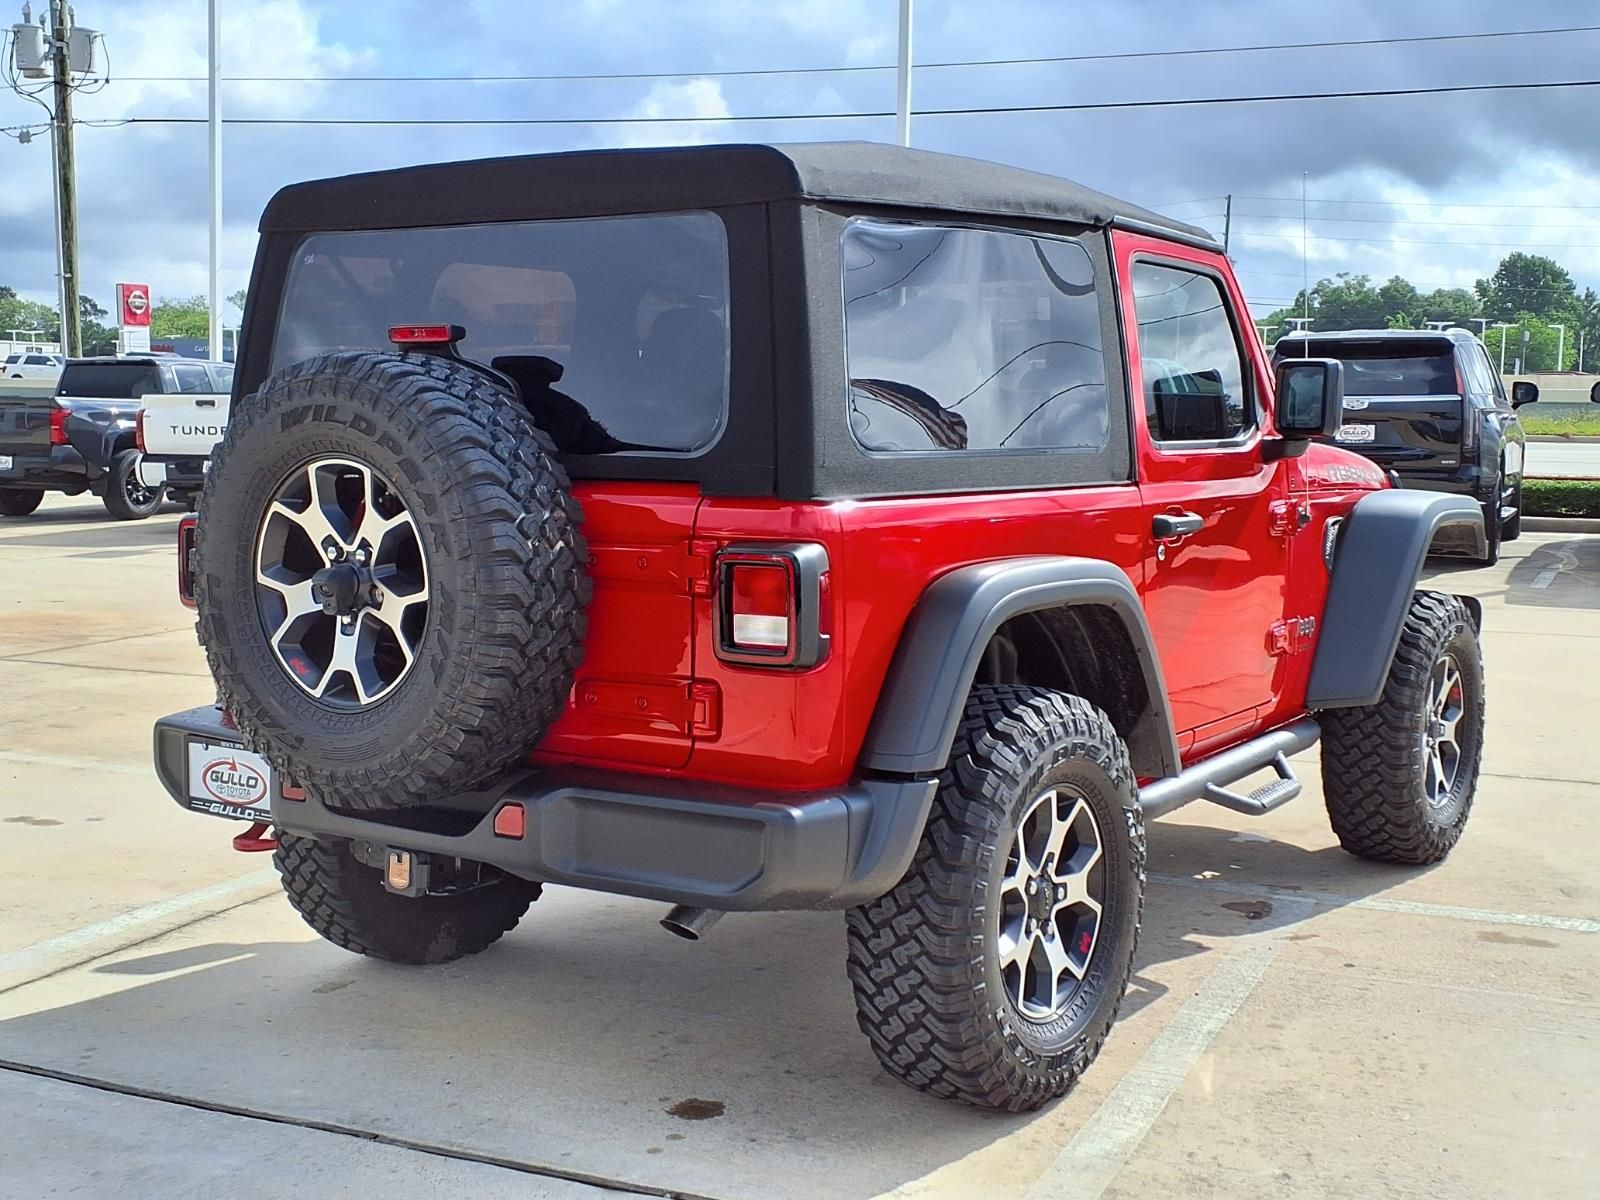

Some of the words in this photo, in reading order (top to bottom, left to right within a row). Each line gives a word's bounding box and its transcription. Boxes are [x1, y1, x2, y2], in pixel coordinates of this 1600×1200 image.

[210, 770, 259, 788] GULLO
[226, 786, 252, 796] TOYOTA
[209, 803, 255, 819] GULLO
